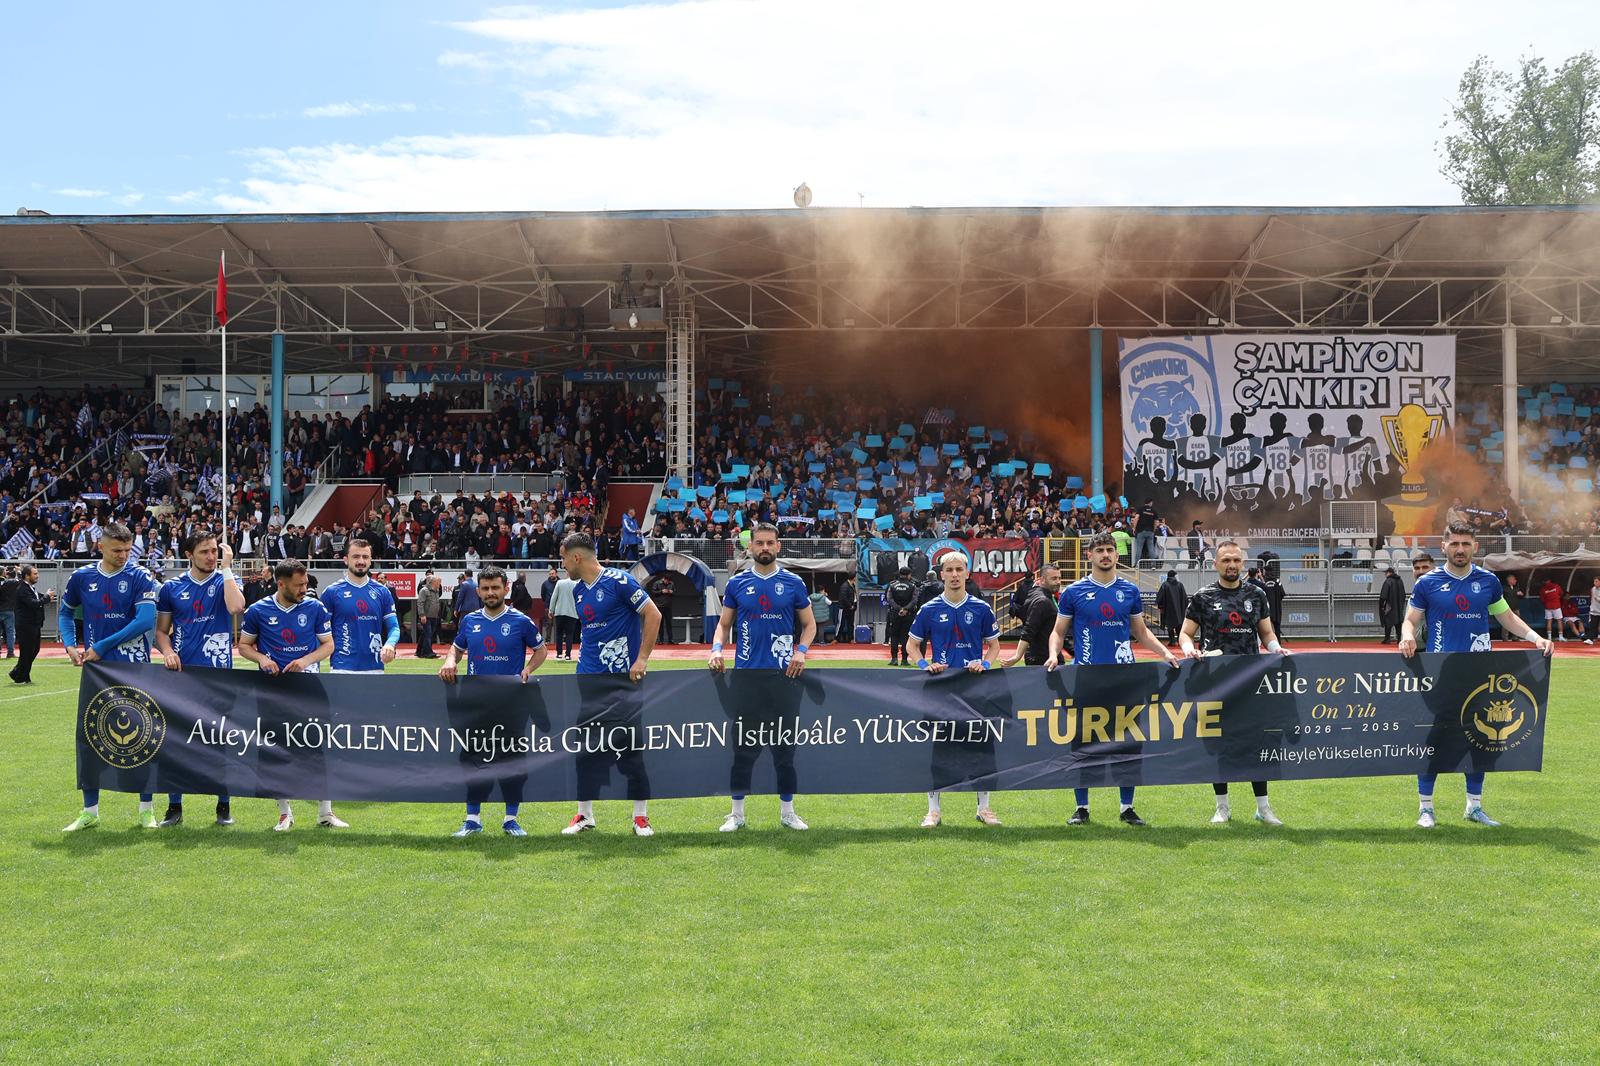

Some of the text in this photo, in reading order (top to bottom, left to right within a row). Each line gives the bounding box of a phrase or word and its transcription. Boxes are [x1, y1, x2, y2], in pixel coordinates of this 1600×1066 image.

[1234, 337, 1422, 378] ŞAMPİYON
[1234, 376, 1452, 416] ÇANKIRI FK
[1230, 452, 1246, 468] 18
[1270, 452, 1286, 470] 18
[1309, 453, 1326, 470] 18
[972, 550, 1028, 577] AÇIK
[1255, 671, 1434, 695] Aile ve Nüfus
[1017, 694, 1223, 746] TÜRKİYE
[1312, 703, 1377, 720] On Yılı
[187, 714, 1005, 762] Aileyle KÖKLENEN Nüfusla GÜÇLENEN İstikbâle YÜKSELEN
[1294, 722, 1399, 734] 2026 2035
[1260, 744, 1435, 764] #AileyleYükselenTürkiye
